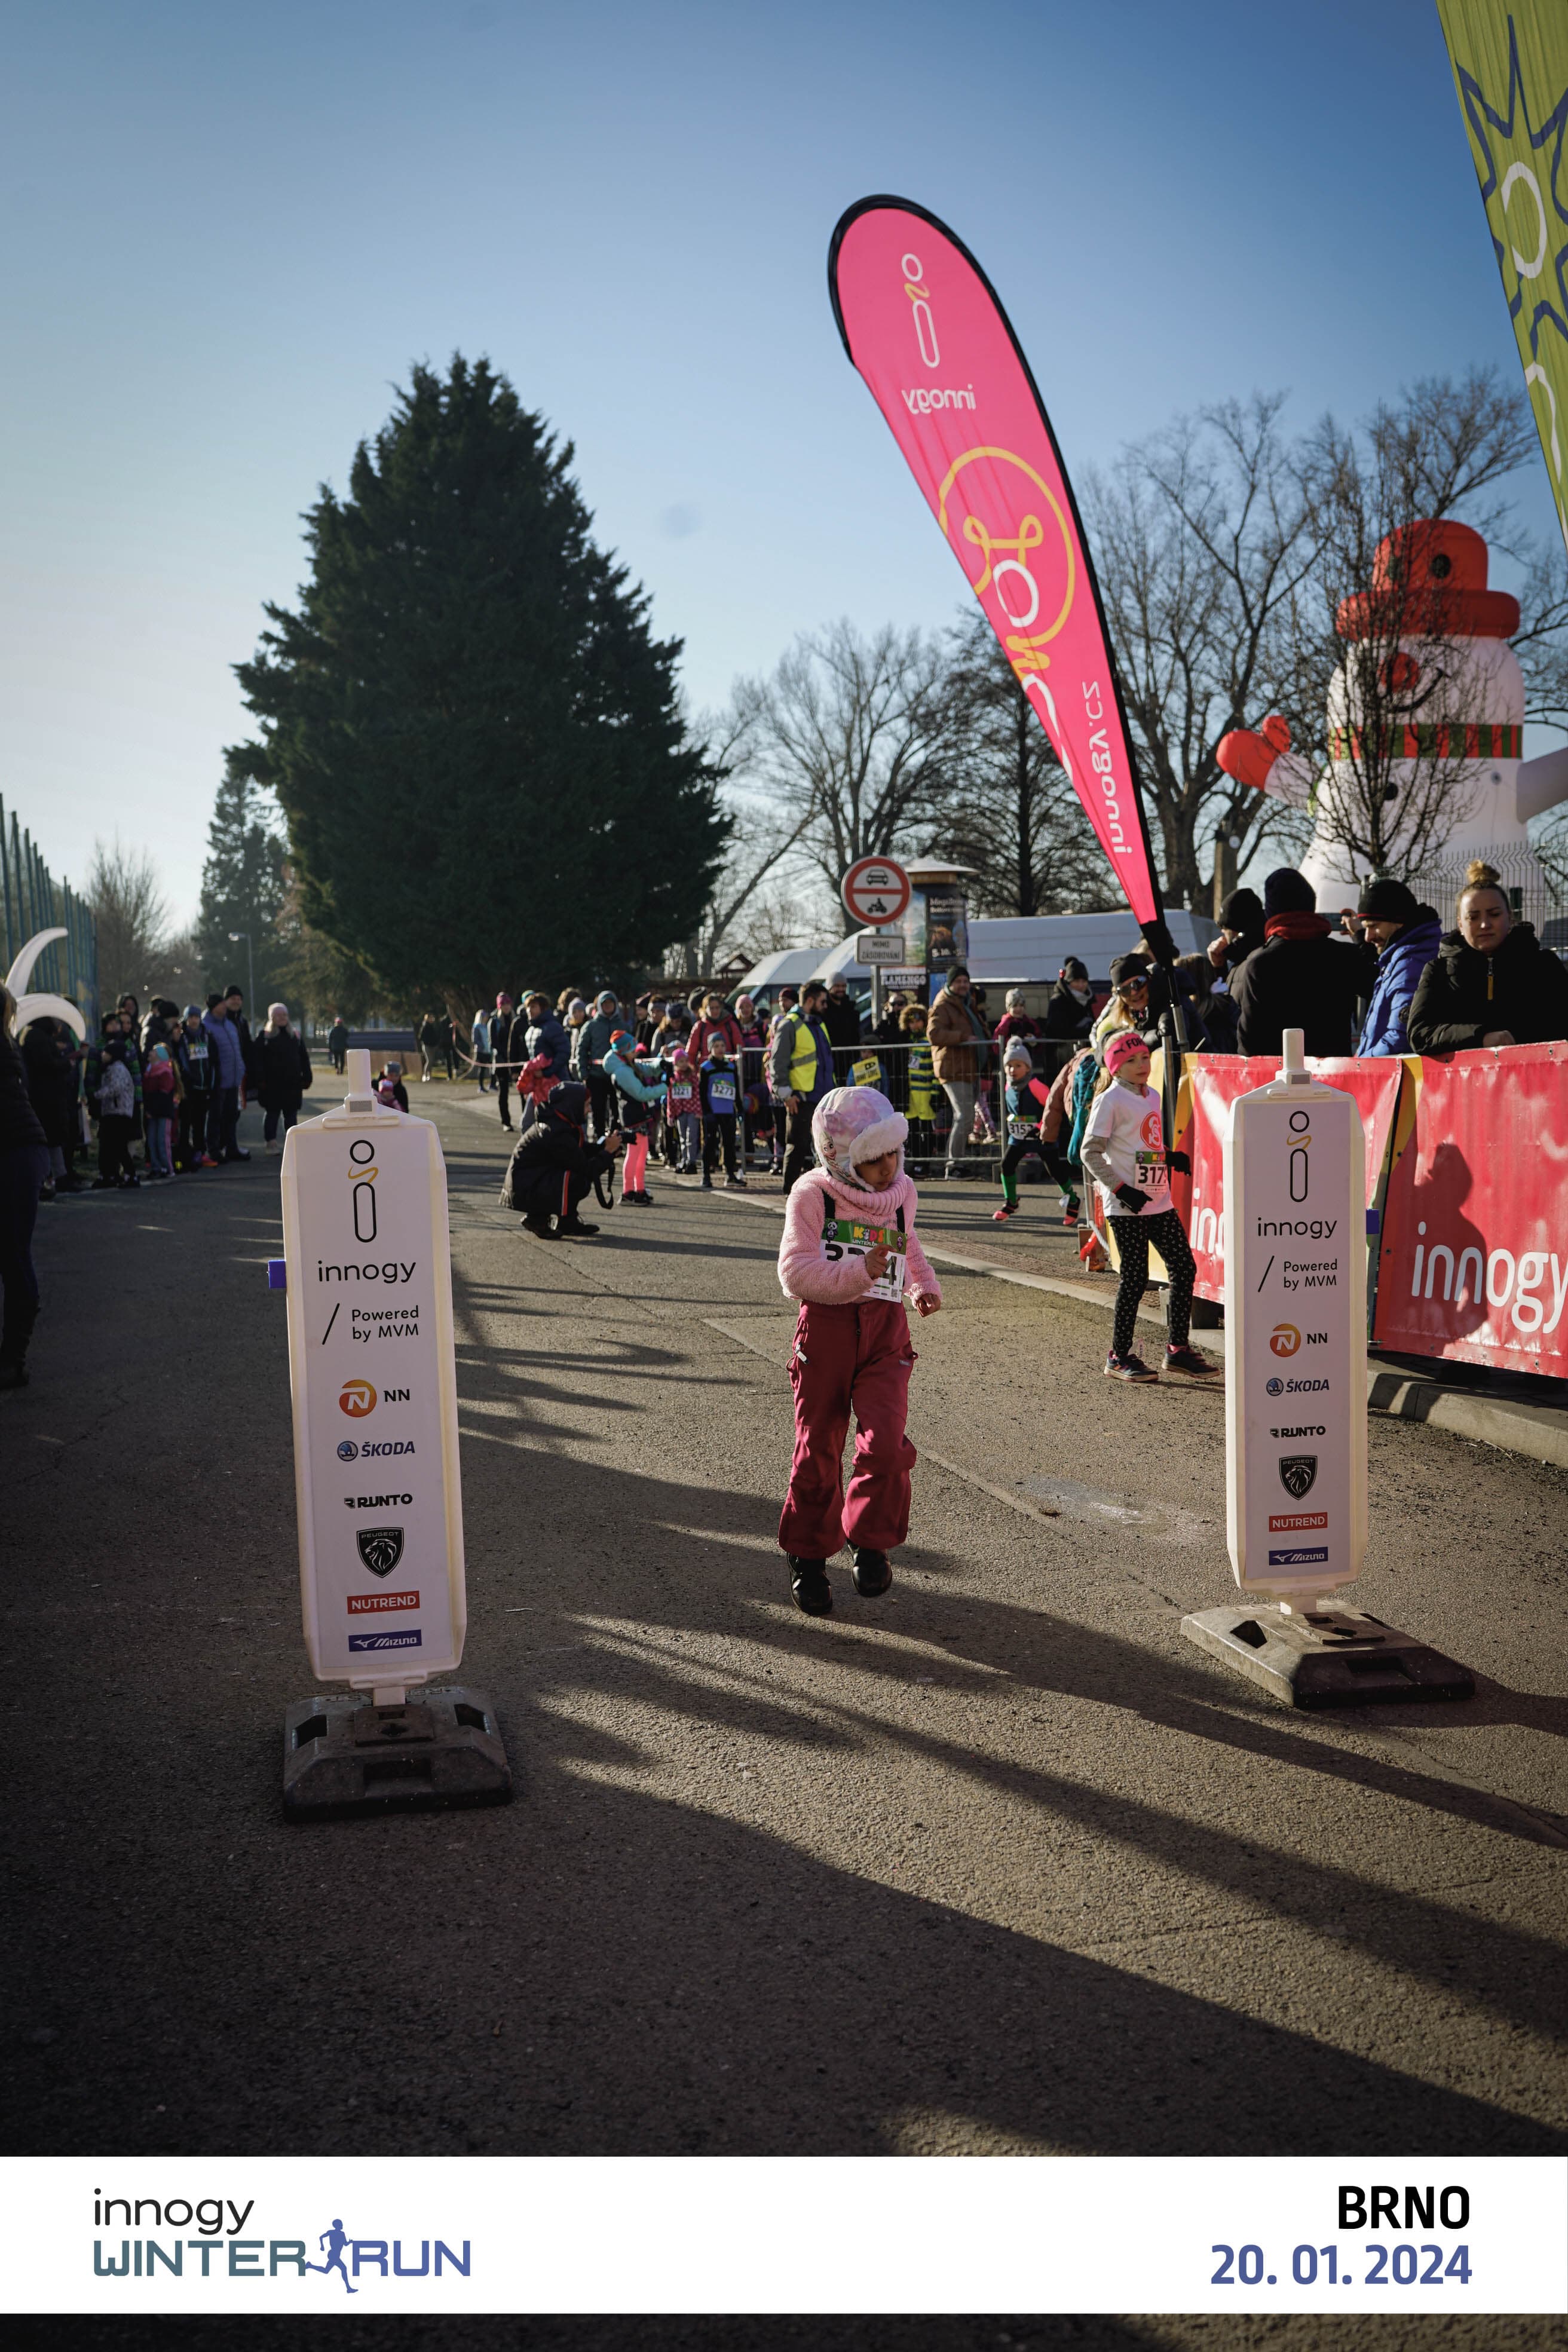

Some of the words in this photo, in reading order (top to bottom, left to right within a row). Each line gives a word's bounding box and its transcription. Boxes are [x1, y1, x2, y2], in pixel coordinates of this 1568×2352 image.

[1138, 1166, 1167, 1184] 317
[1257, 1217, 1337, 1239] innogy
[318, 1260, 416, 1284] innogy
[1284, 1258, 1337, 1272] Powered
[1284, 1276, 1300, 1291] by
[1304, 1275, 1337, 1287] MVM
[1411, 1221, 1568, 1334] innogy
[351, 1305, 419, 1321] Powered
[352, 1326, 372, 1343] by
[378, 1323, 419, 1338] MVM
[1307, 1333, 1328, 1344] NN
[1285, 1379, 1330, 1393] ŠKODA
[383, 1389, 410, 1402] NN
[1281, 1425, 1326, 1438] RUNTO
[361, 1441, 415, 1457] ŠKODA
[357, 1493, 413, 1508] RUNTO
[1272, 1515, 1325, 1529] NUTREND
[351, 1595, 416, 1610] NUTREND
